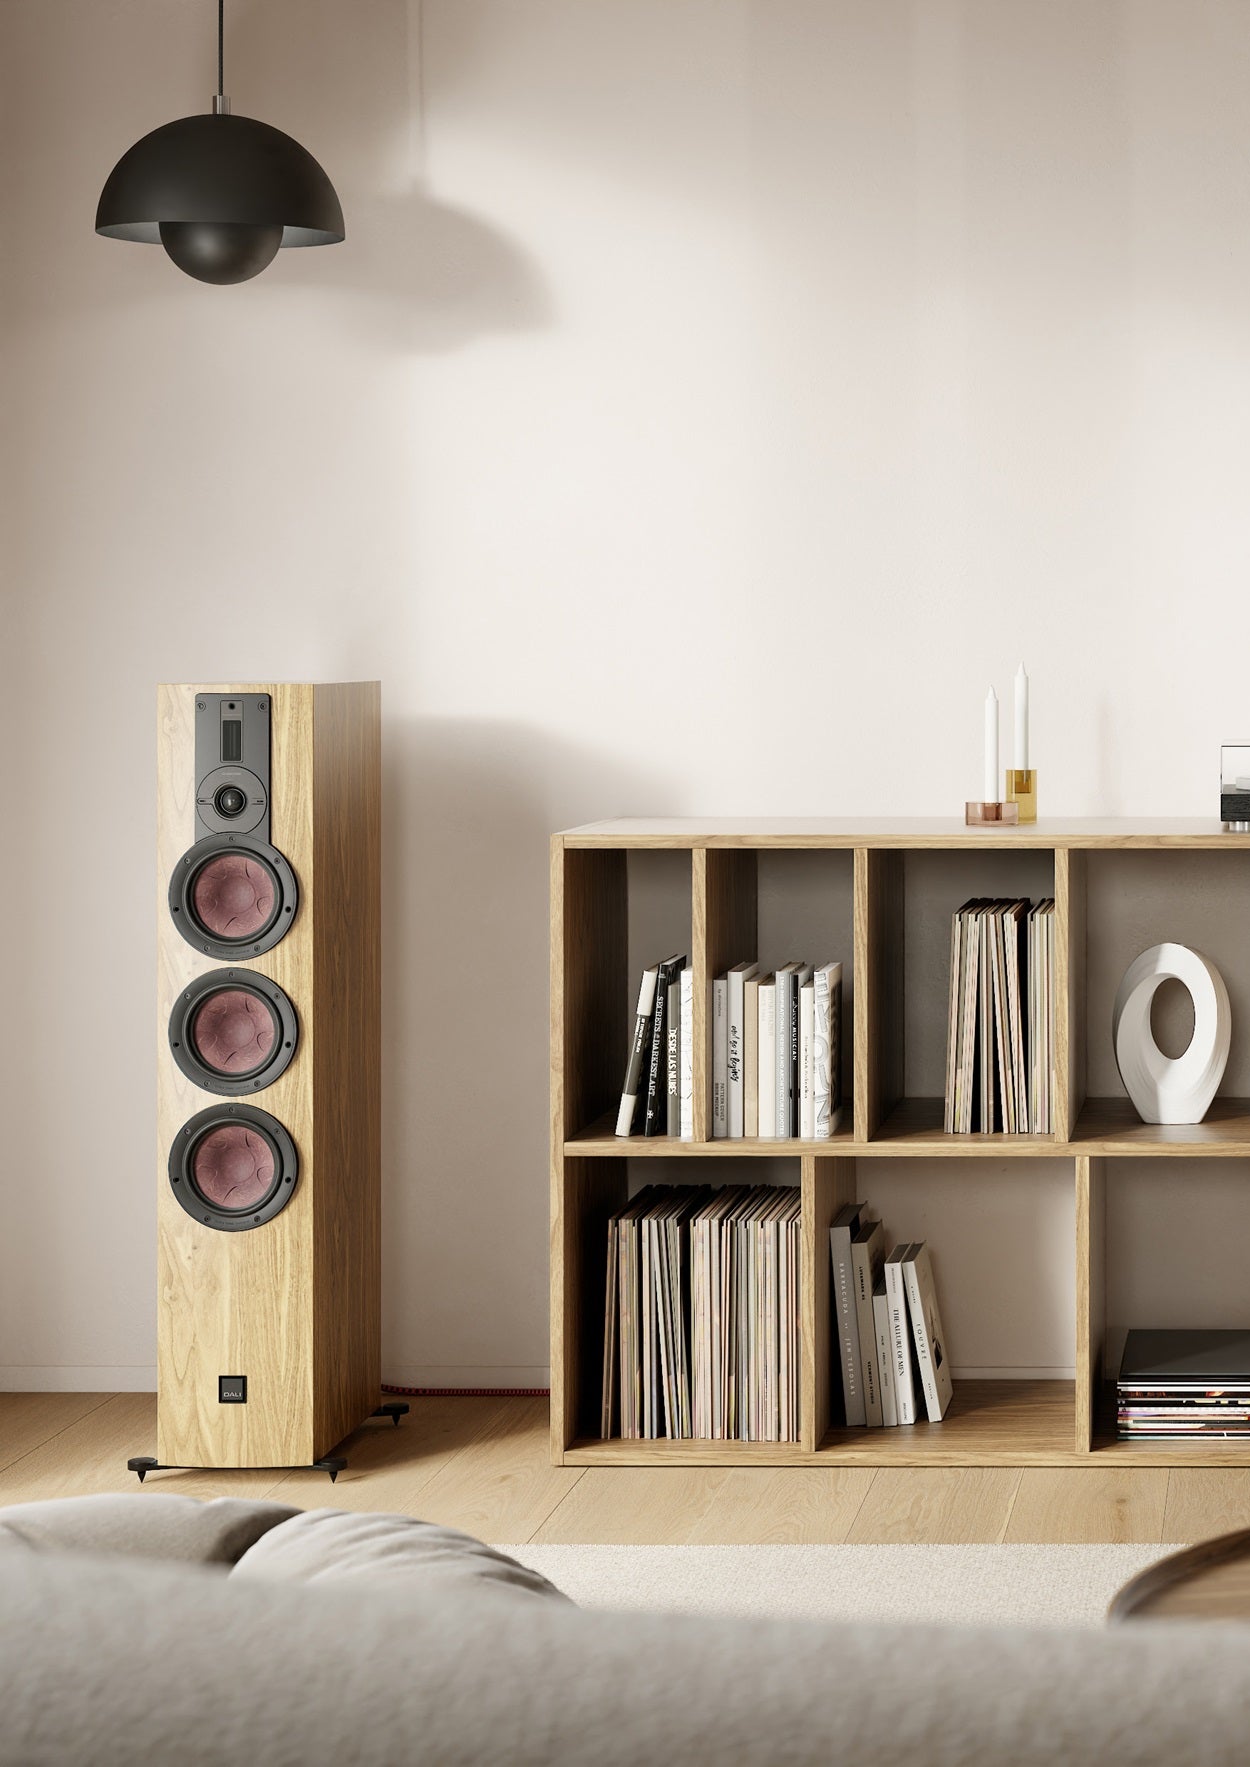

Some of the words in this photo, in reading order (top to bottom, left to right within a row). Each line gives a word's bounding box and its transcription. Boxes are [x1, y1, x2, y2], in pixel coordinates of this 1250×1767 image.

[653, 996, 664, 1032] SECRETS
[650, 1040, 660, 1078] DARKEST
[668, 1055, 677, 1070] LAS
[648, 1080, 656, 1096] ART
